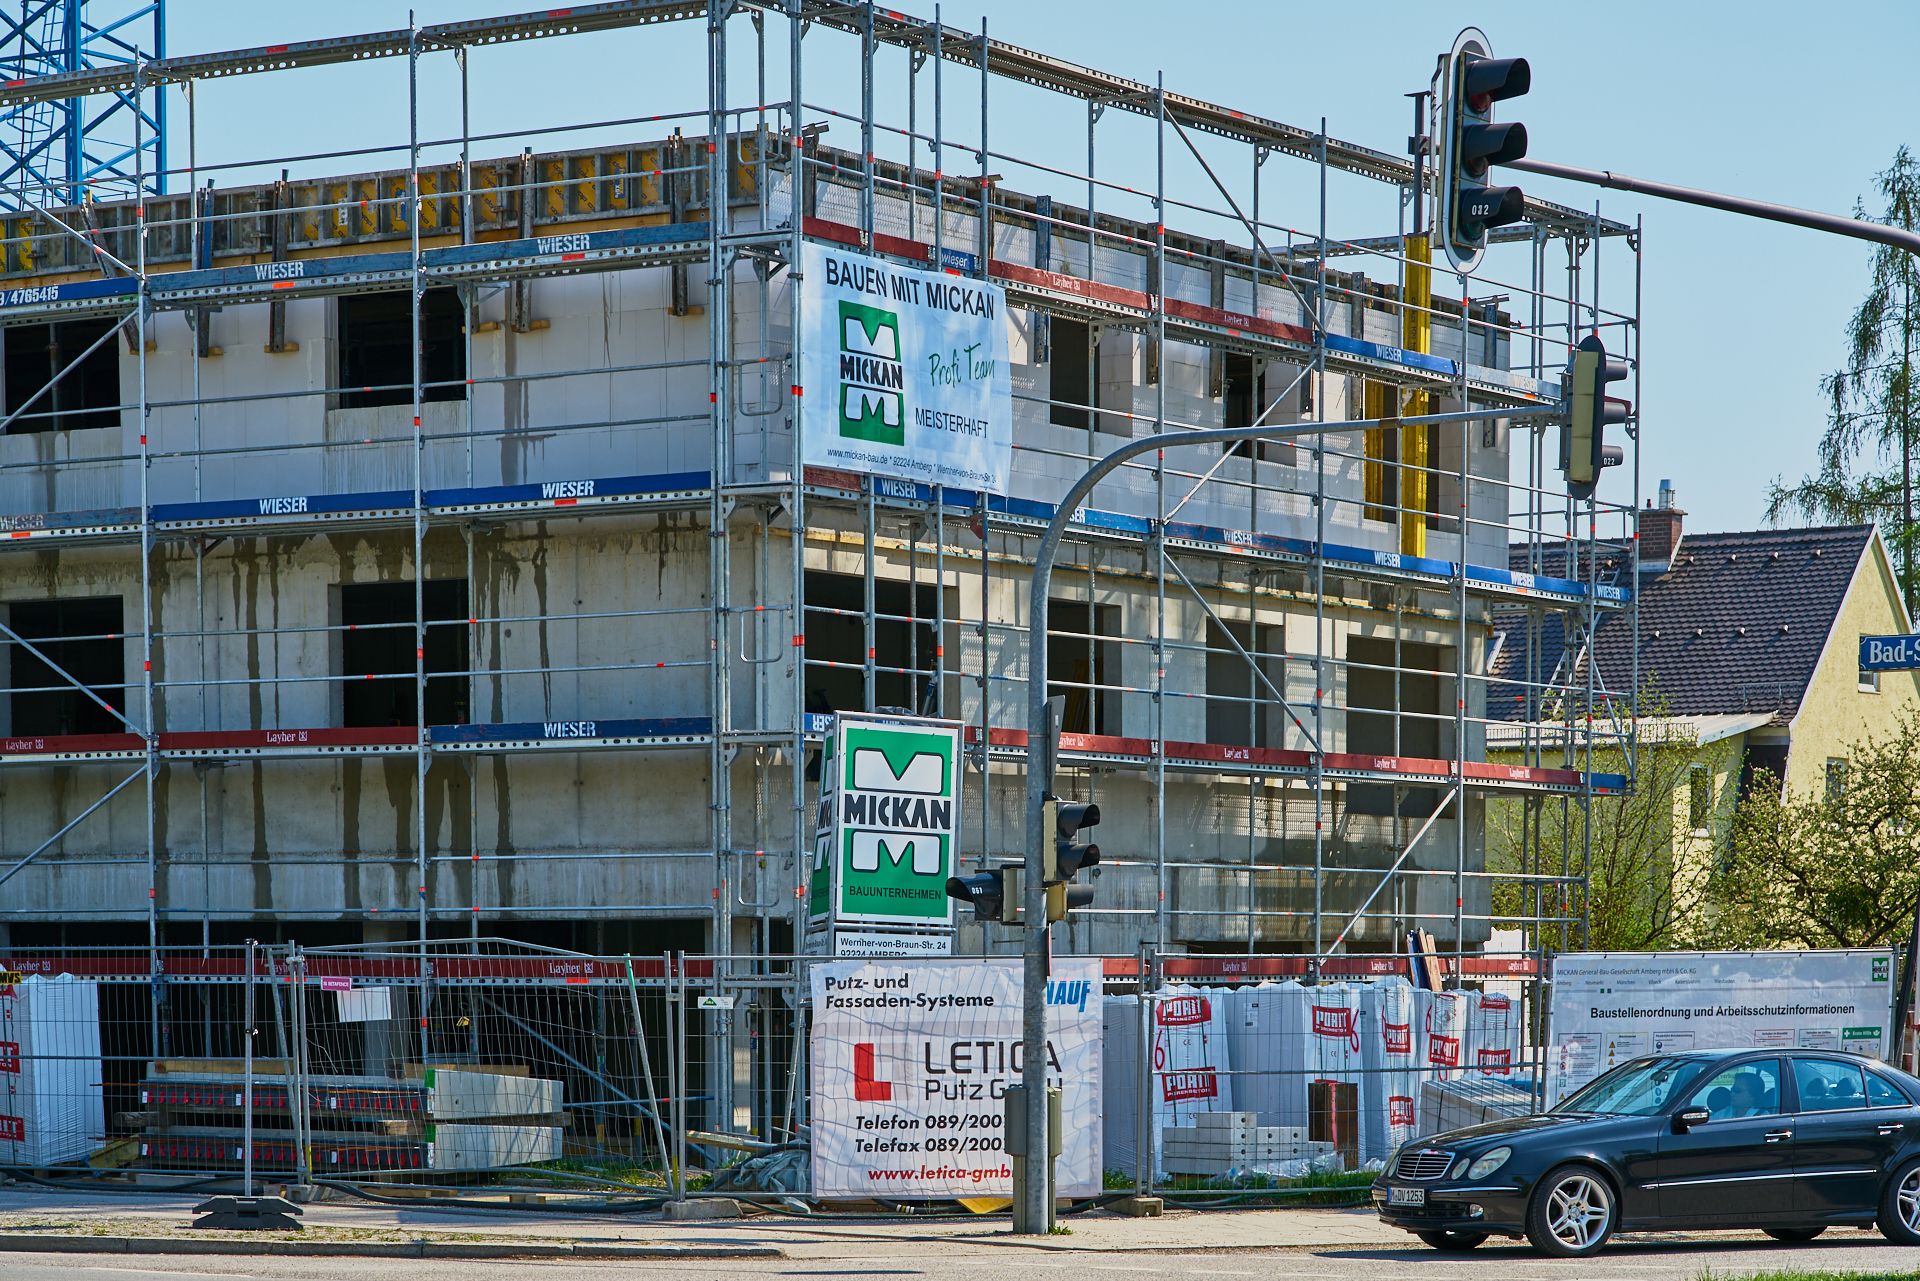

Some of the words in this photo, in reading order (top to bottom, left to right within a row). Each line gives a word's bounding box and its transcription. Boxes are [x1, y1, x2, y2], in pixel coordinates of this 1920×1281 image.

[1472, 204, 1489, 216] 032
[537, 234, 590, 255] WIESER
[941, 253, 968, 267] wieser
[254, 261, 305, 281] WIESER
[826, 257, 887, 298] BAUEN
[890, 276, 920, 305] MIT
[926, 281, 994, 321] MICKAN
[1053, 275, 1073, 289] Layher
[1375, 344, 1402, 363] WIESER
[840, 354, 903, 390] MICKAN
[928, 351, 961, 388] Profi
[964, 343, 995, 378] Team
[915, 407, 988, 439] MEISTERHAFT
[827, 448, 888, 465] www.mickan-bau.de
[893, 456, 910, 468] 92224
[911, 459, 932, 474] Amberg
[542, 480, 595, 499] WIESER
[881, 479, 917, 499] WIESER
[259, 497, 308, 515] WIESER
[1053, 504, 1086, 524] WSER
[1223, 530, 1253, 546] WIESER
[1374, 551, 1401, 568] WIESER
[1511, 571, 1535, 588] WIESER
[1597, 585, 1621, 600] WIESER
[266, 731, 296, 745] Layher
[543, 721, 596, 738] WIESER
[5, 739, 33, 751] Layher
[1224, 747, 1243, 760] Layher
[843, 794, 951, 831] MICKAN
[849, 885, 942, 900] BAUUNTERNEHMEN
[840, 937, 935, 950] Wernher-von-Braun-Str.
[937, 941, 947, 950] 24
[13, 961, 40, 973] Layher
[549, 962, 581, 976] Layher
[1222, 961, 1240, 974] Layher
[1371, 961, 1388, 974] Layher
[825, 976, 868, 991] Putz-
[874, 973, 909, 989] und
[825, 992, 995, 1012] Fassaden-Systeme
[1046, 980, 1092, 1013] NAUF
[1590, 1005, 1691, 1020] Baustellenordnung
[1694, 1006, 1714, 1017] und
[1715, 1003, 1855, 1017] Arbeitsschutzinformationen
[925, 1079, 983, 1101] Putz
[856, 1115, 920, 1130] Telefon
[925, 1113, 1005, 1132] 089/200
[855, 1138, 920, 1153] Telefax
[925, 1136, 1005, 1154] 089/200
[868, 1163, 1013, 1183] www.letica-gmb
[1406, 1190, 1424, 1203] 1253
